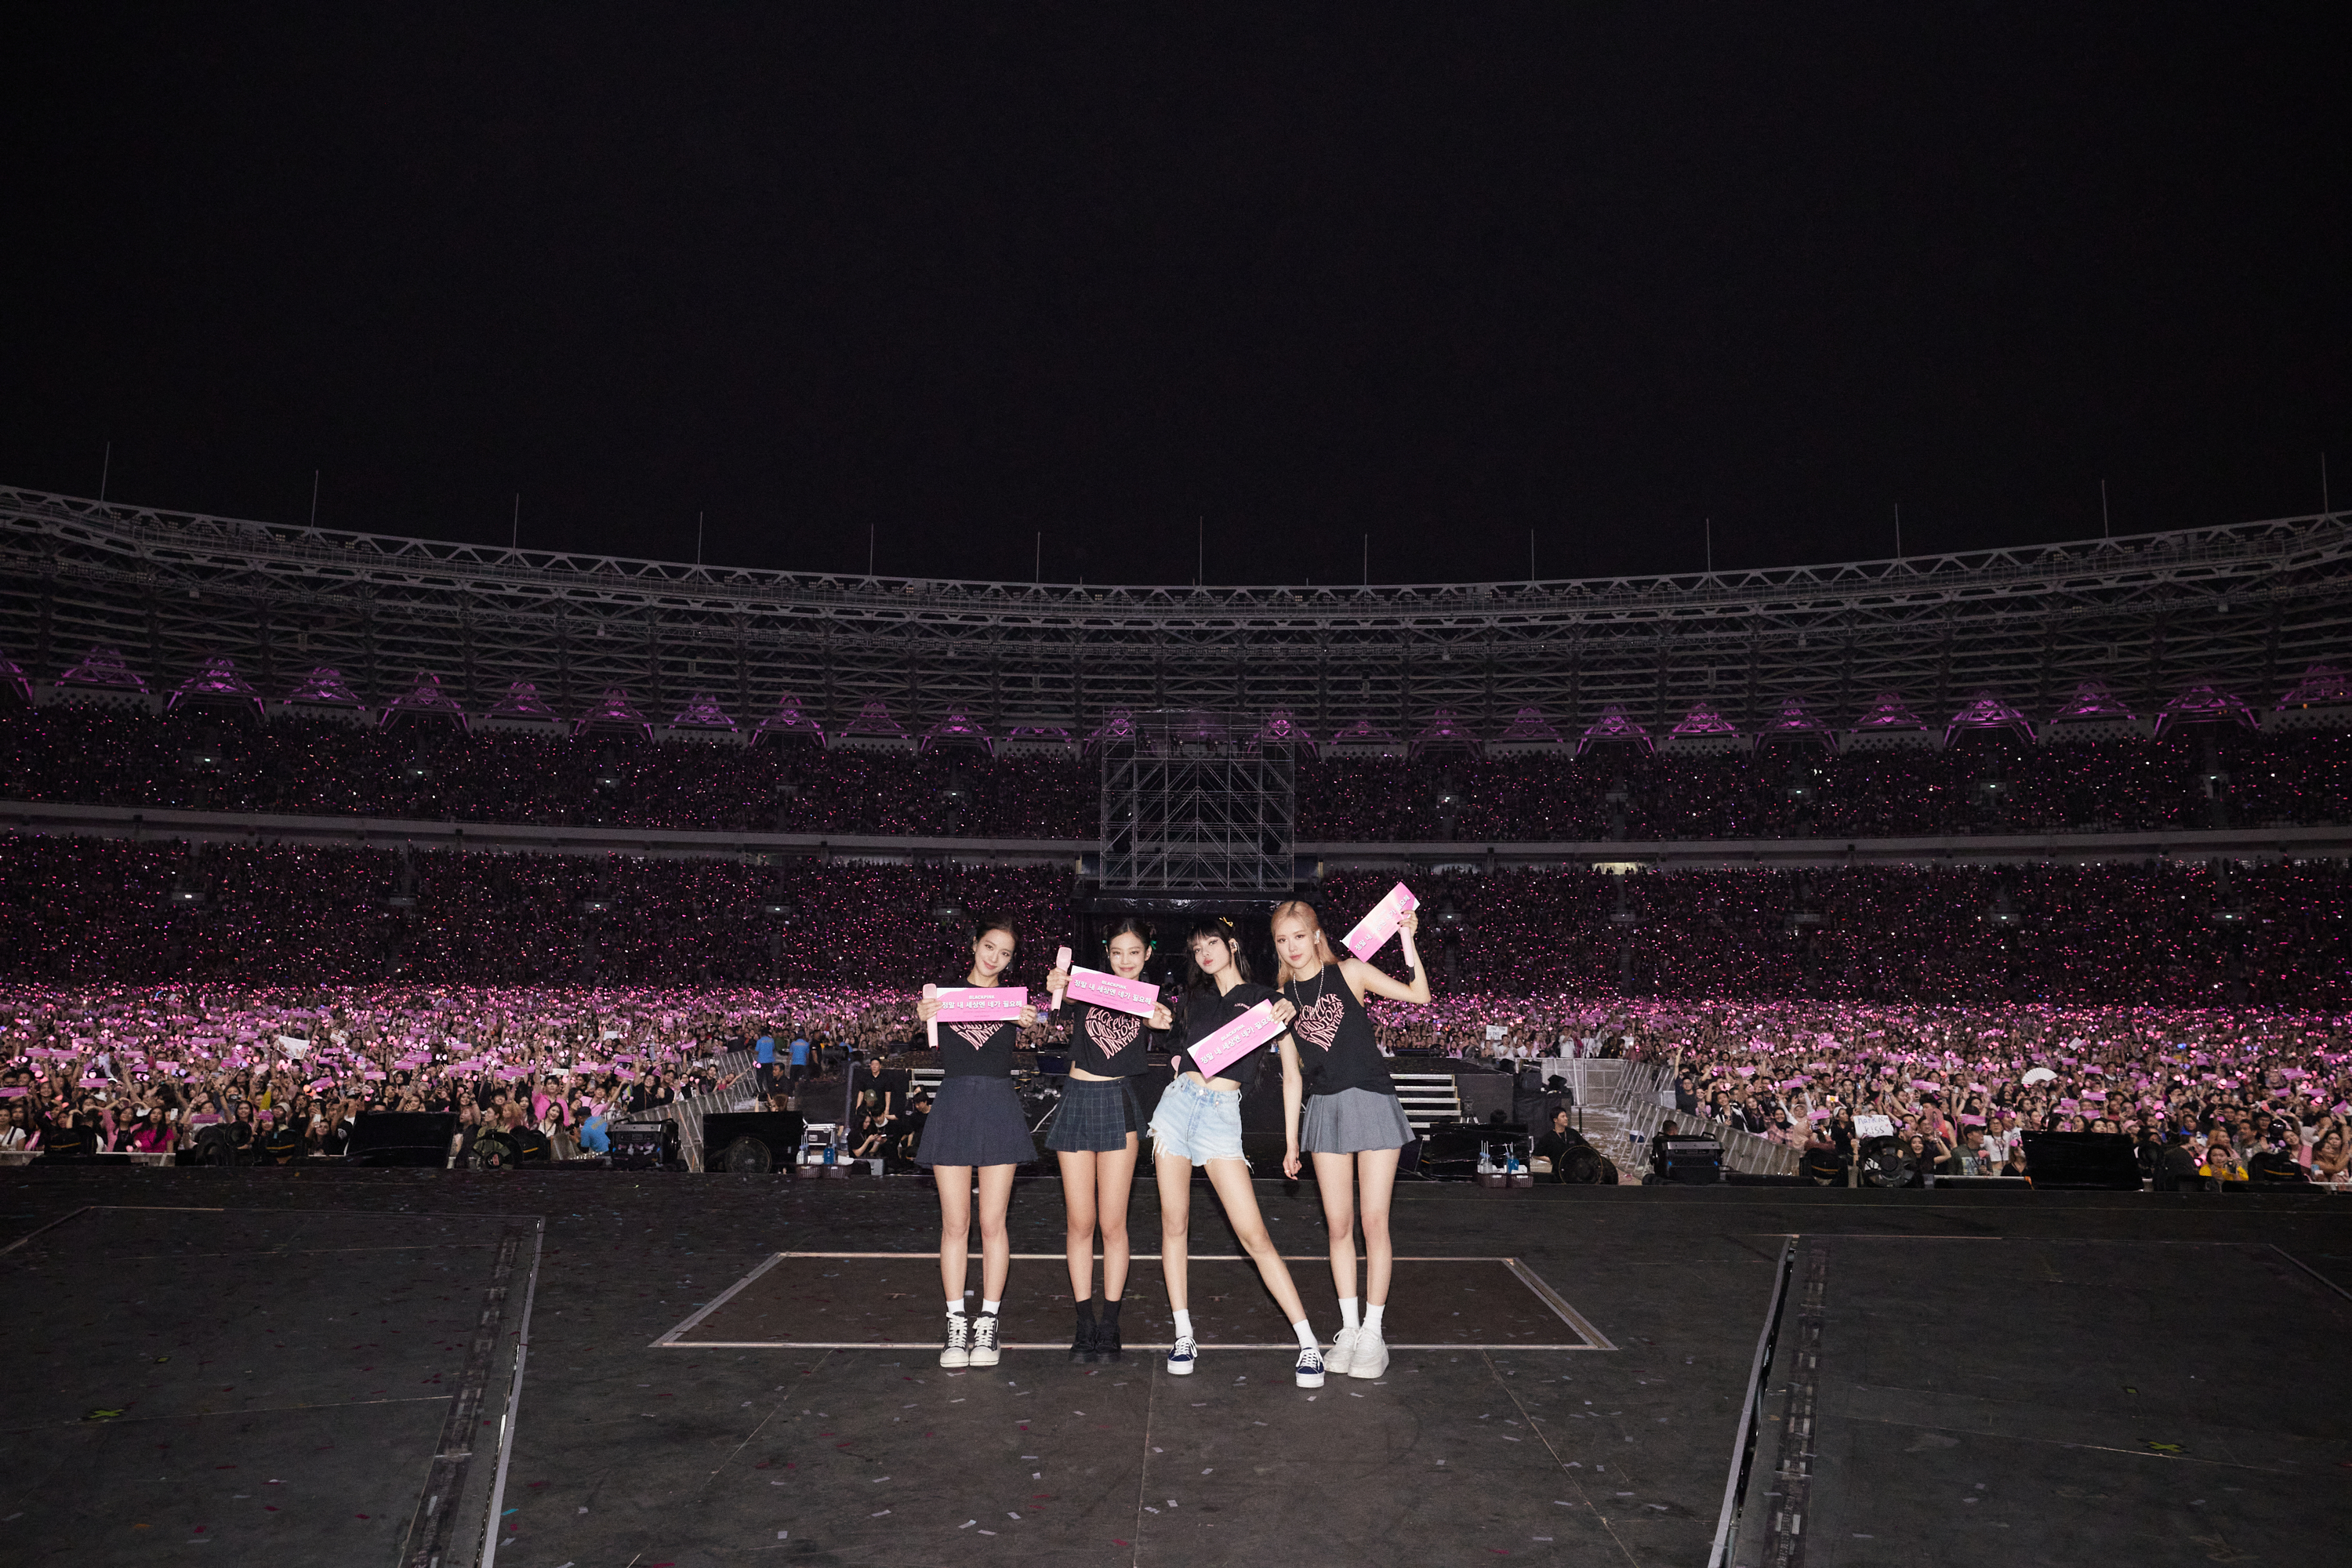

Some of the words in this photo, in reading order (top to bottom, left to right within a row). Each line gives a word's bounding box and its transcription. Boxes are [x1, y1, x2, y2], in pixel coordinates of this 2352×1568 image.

[1354, 939, 1367, 951] 정말
[1074, 979, 1087, 988] 정말
[1097, 985, 1116, 996] 세상엔
[1118, 990, 1131, 1000] 네가
[1132, 994, 1152, 1005] 필요해
[1102, 980, 1127, 990] BLACKPINK
[1319, 1002, 1344, 1025] TOUR
[1113, 1021, 1141, 1039] TOUR
[1221, 1024, 1245, 1041] BLACKPINK
[1200, 1053, 1214, 1064] 정말
[1221, 1036, 1241, 1051] 세상엔
[1241, 1027, 1255, 1038] 네가
